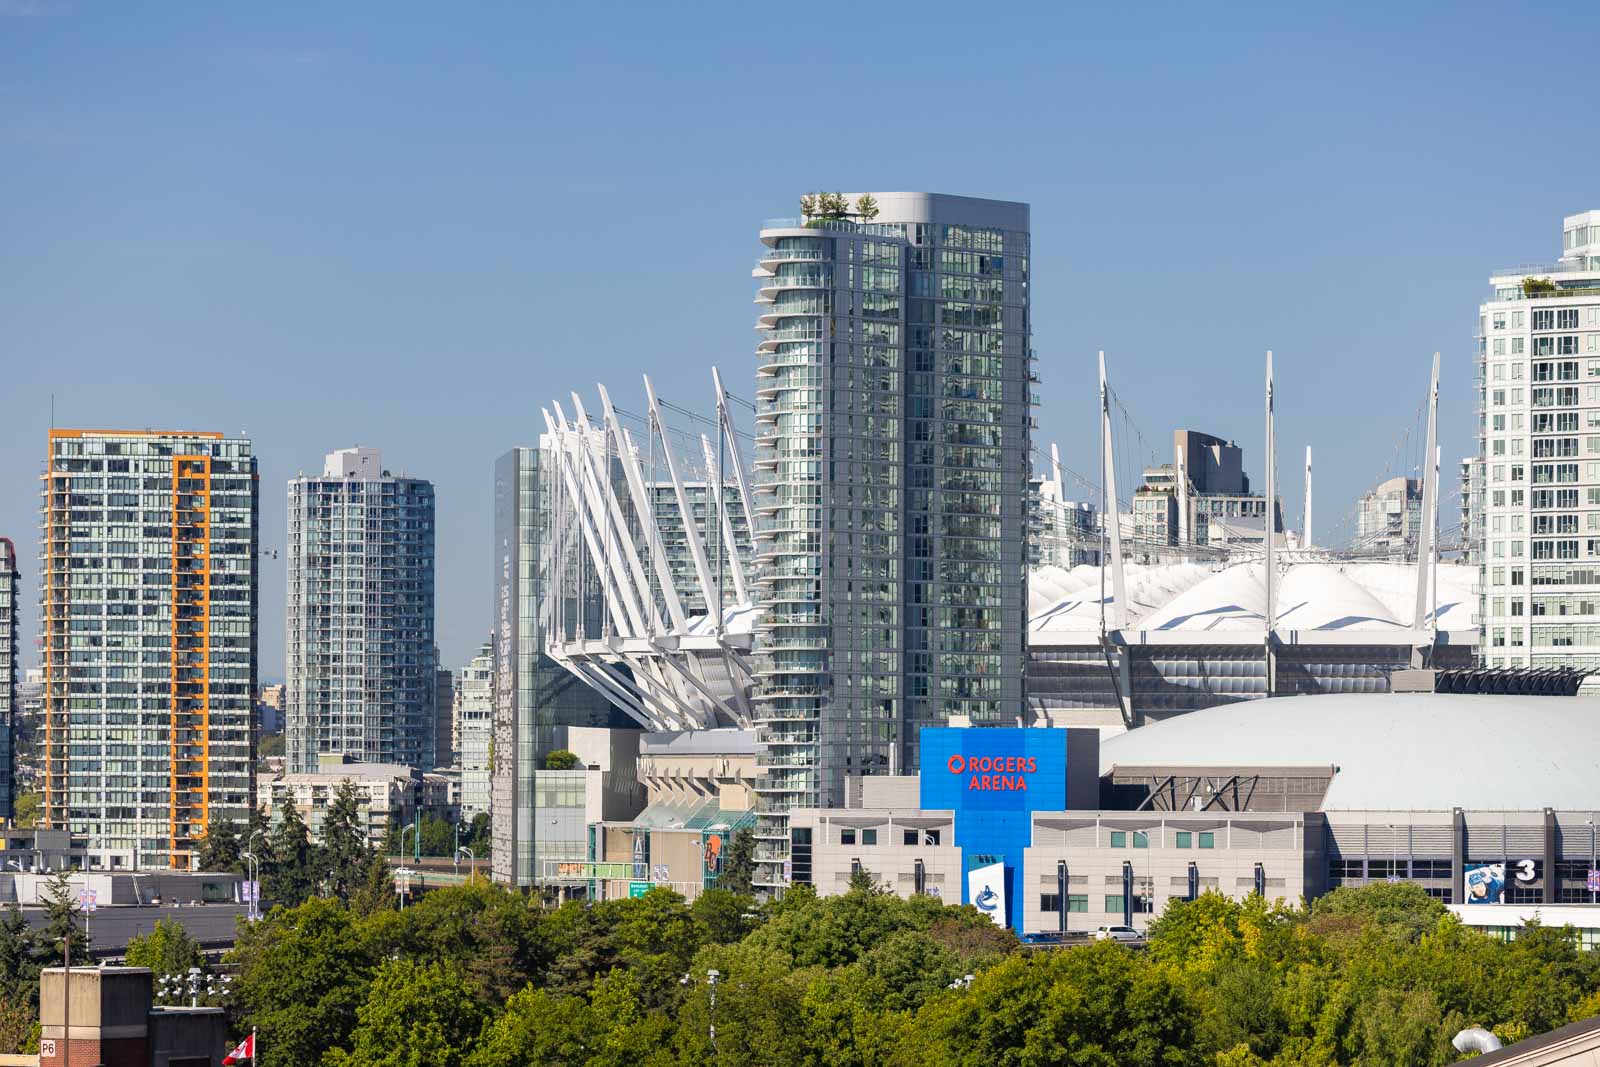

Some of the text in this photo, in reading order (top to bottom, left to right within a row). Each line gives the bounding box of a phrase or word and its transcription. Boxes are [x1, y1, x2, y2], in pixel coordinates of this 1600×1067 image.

[969, 756, 1037, 773] ROGERS
[969, 775, 1027, 791] ARENA
[1515, 859, 1536, 881] 3
[42, 1043, 54, 1054] P6
